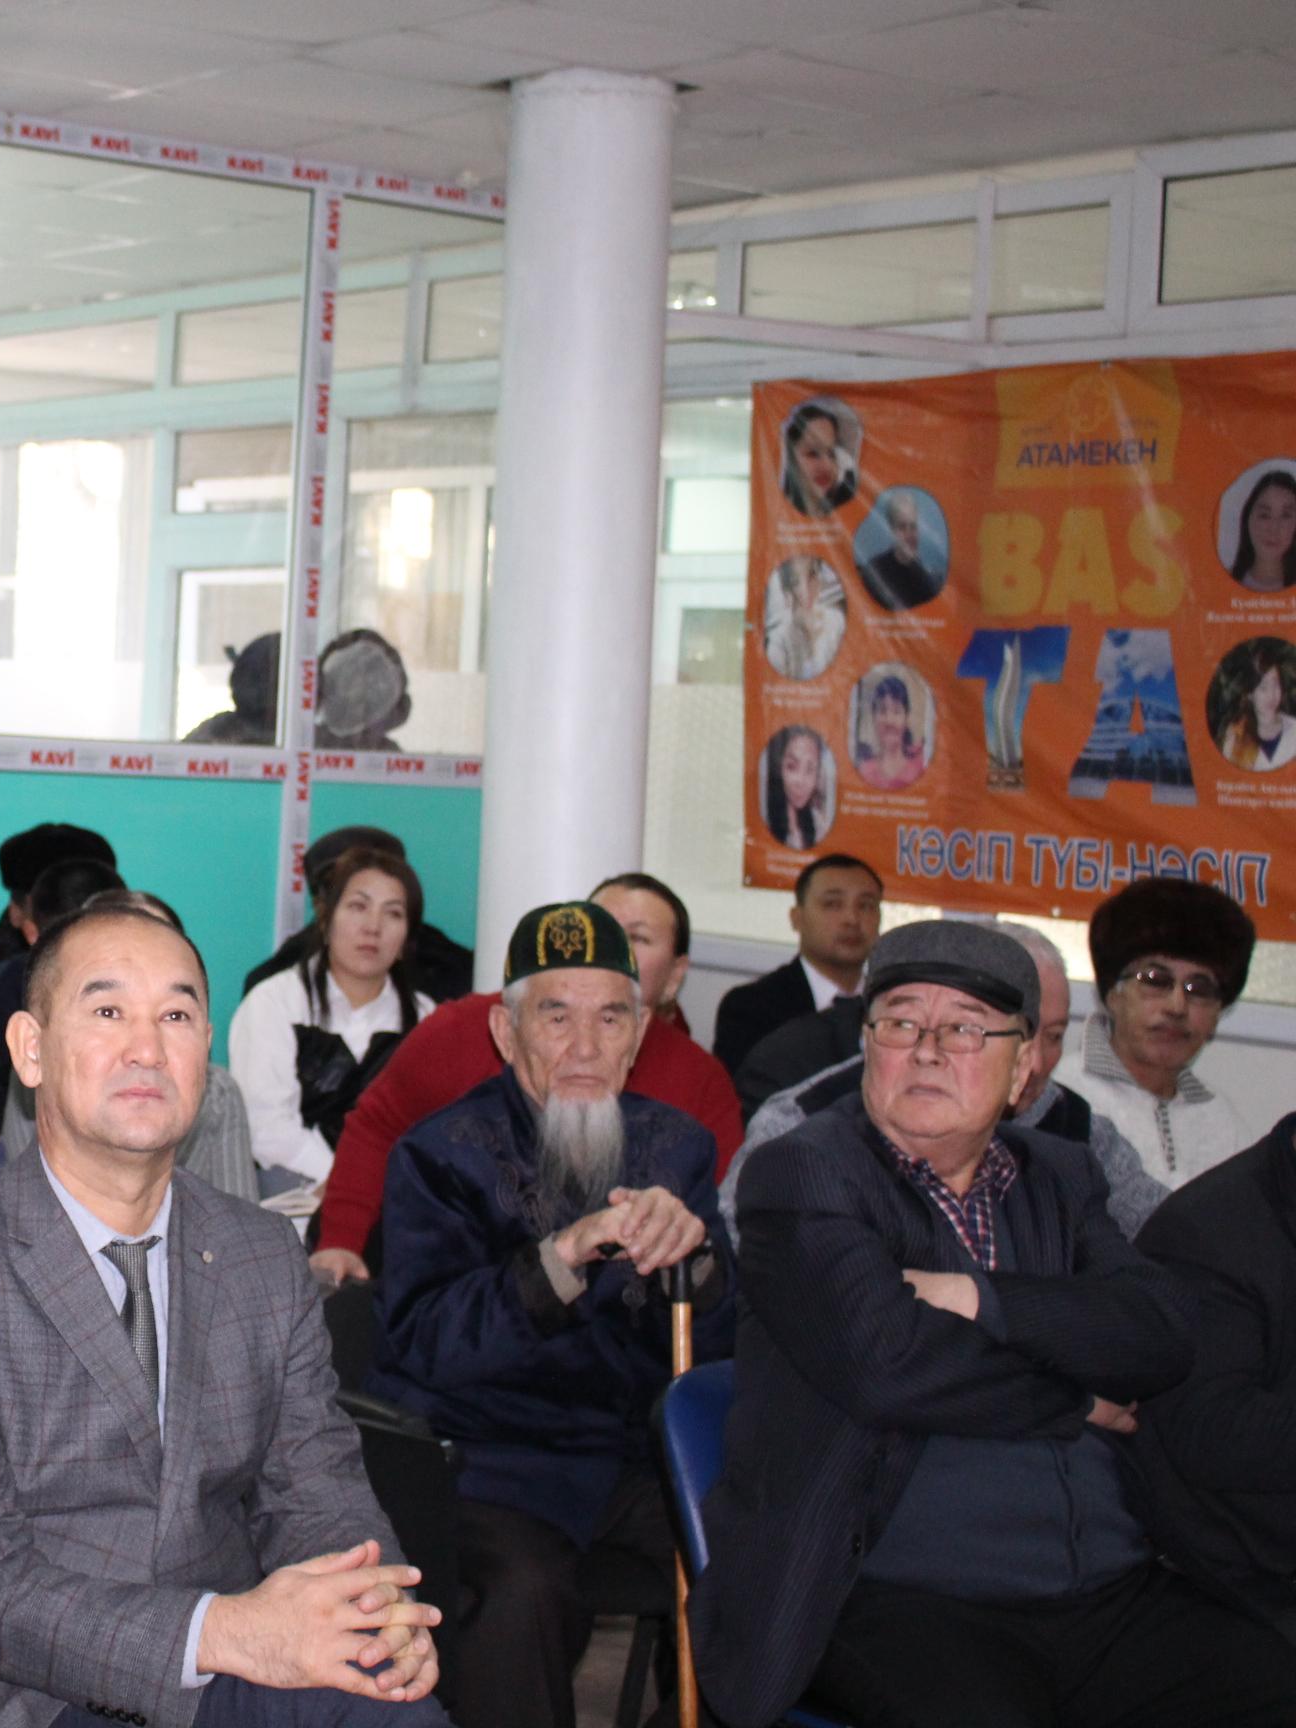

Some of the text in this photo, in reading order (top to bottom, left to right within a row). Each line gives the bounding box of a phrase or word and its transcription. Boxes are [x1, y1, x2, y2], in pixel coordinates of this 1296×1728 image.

[1015, 437, 1159, 469] АТАМЕКЕН
[976, 506, 1185, 618] BAS
[956, 623, 1199, 807] TA
[897, 824, 1014, 886] КӘСІП
